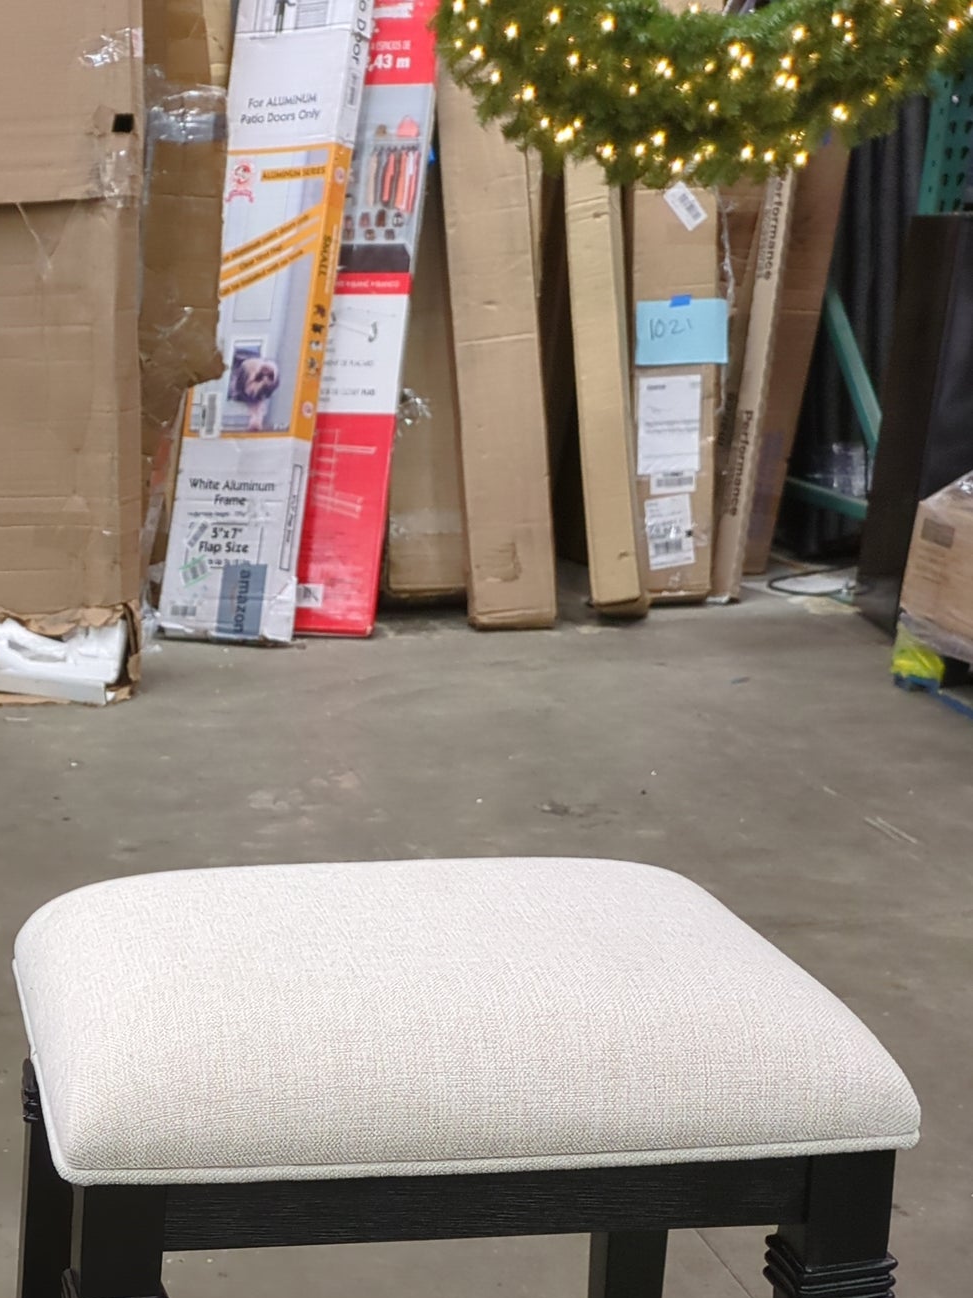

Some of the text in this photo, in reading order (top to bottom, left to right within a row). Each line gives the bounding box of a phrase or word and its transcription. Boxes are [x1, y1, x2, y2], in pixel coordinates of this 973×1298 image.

[368, 53, 411, 72] ,43 m
[247, 92, 317, 109] For ALUMINUM
[240, 108, 321, 125] Patio Doors Only
[765, 180, 784, 280] erformance
[318, 234, 331, 277] SMALL
[650, 318, 693, 340] 1021
[730, 409, 754, 517] Performance
[188, 478, 275, 492] White Aluminum
[213, 494, 247, 506] Frame
[199, 541, 249, 555] Flap Size
[233, 569, 251, 633] amazon
